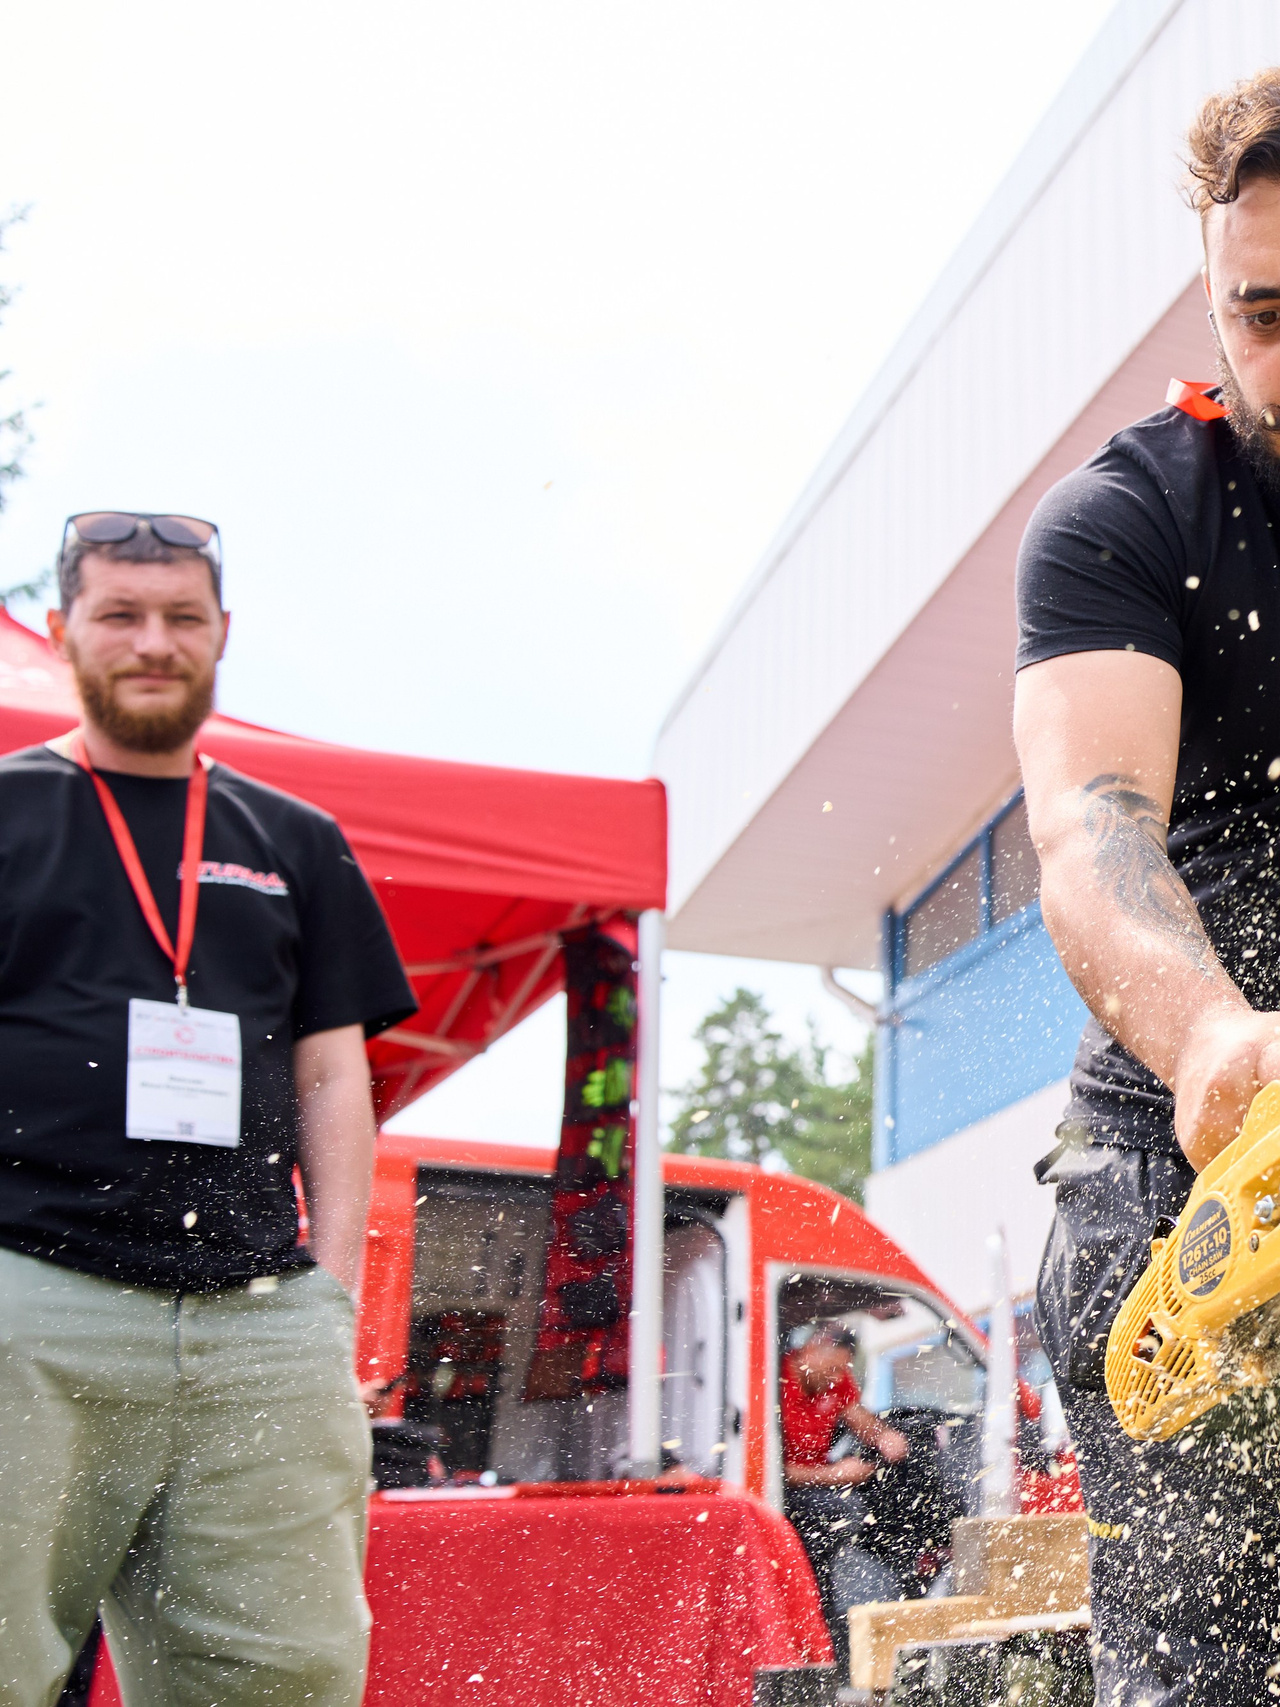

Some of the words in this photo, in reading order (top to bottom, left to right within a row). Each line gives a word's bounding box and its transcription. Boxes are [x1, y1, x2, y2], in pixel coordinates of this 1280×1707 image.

[1181, 1226, 1227, 1271] 126T-10
[1188, 1258, 1209, 1278] CHAIN
[1209, 1249, 1224, 1264] SAW
